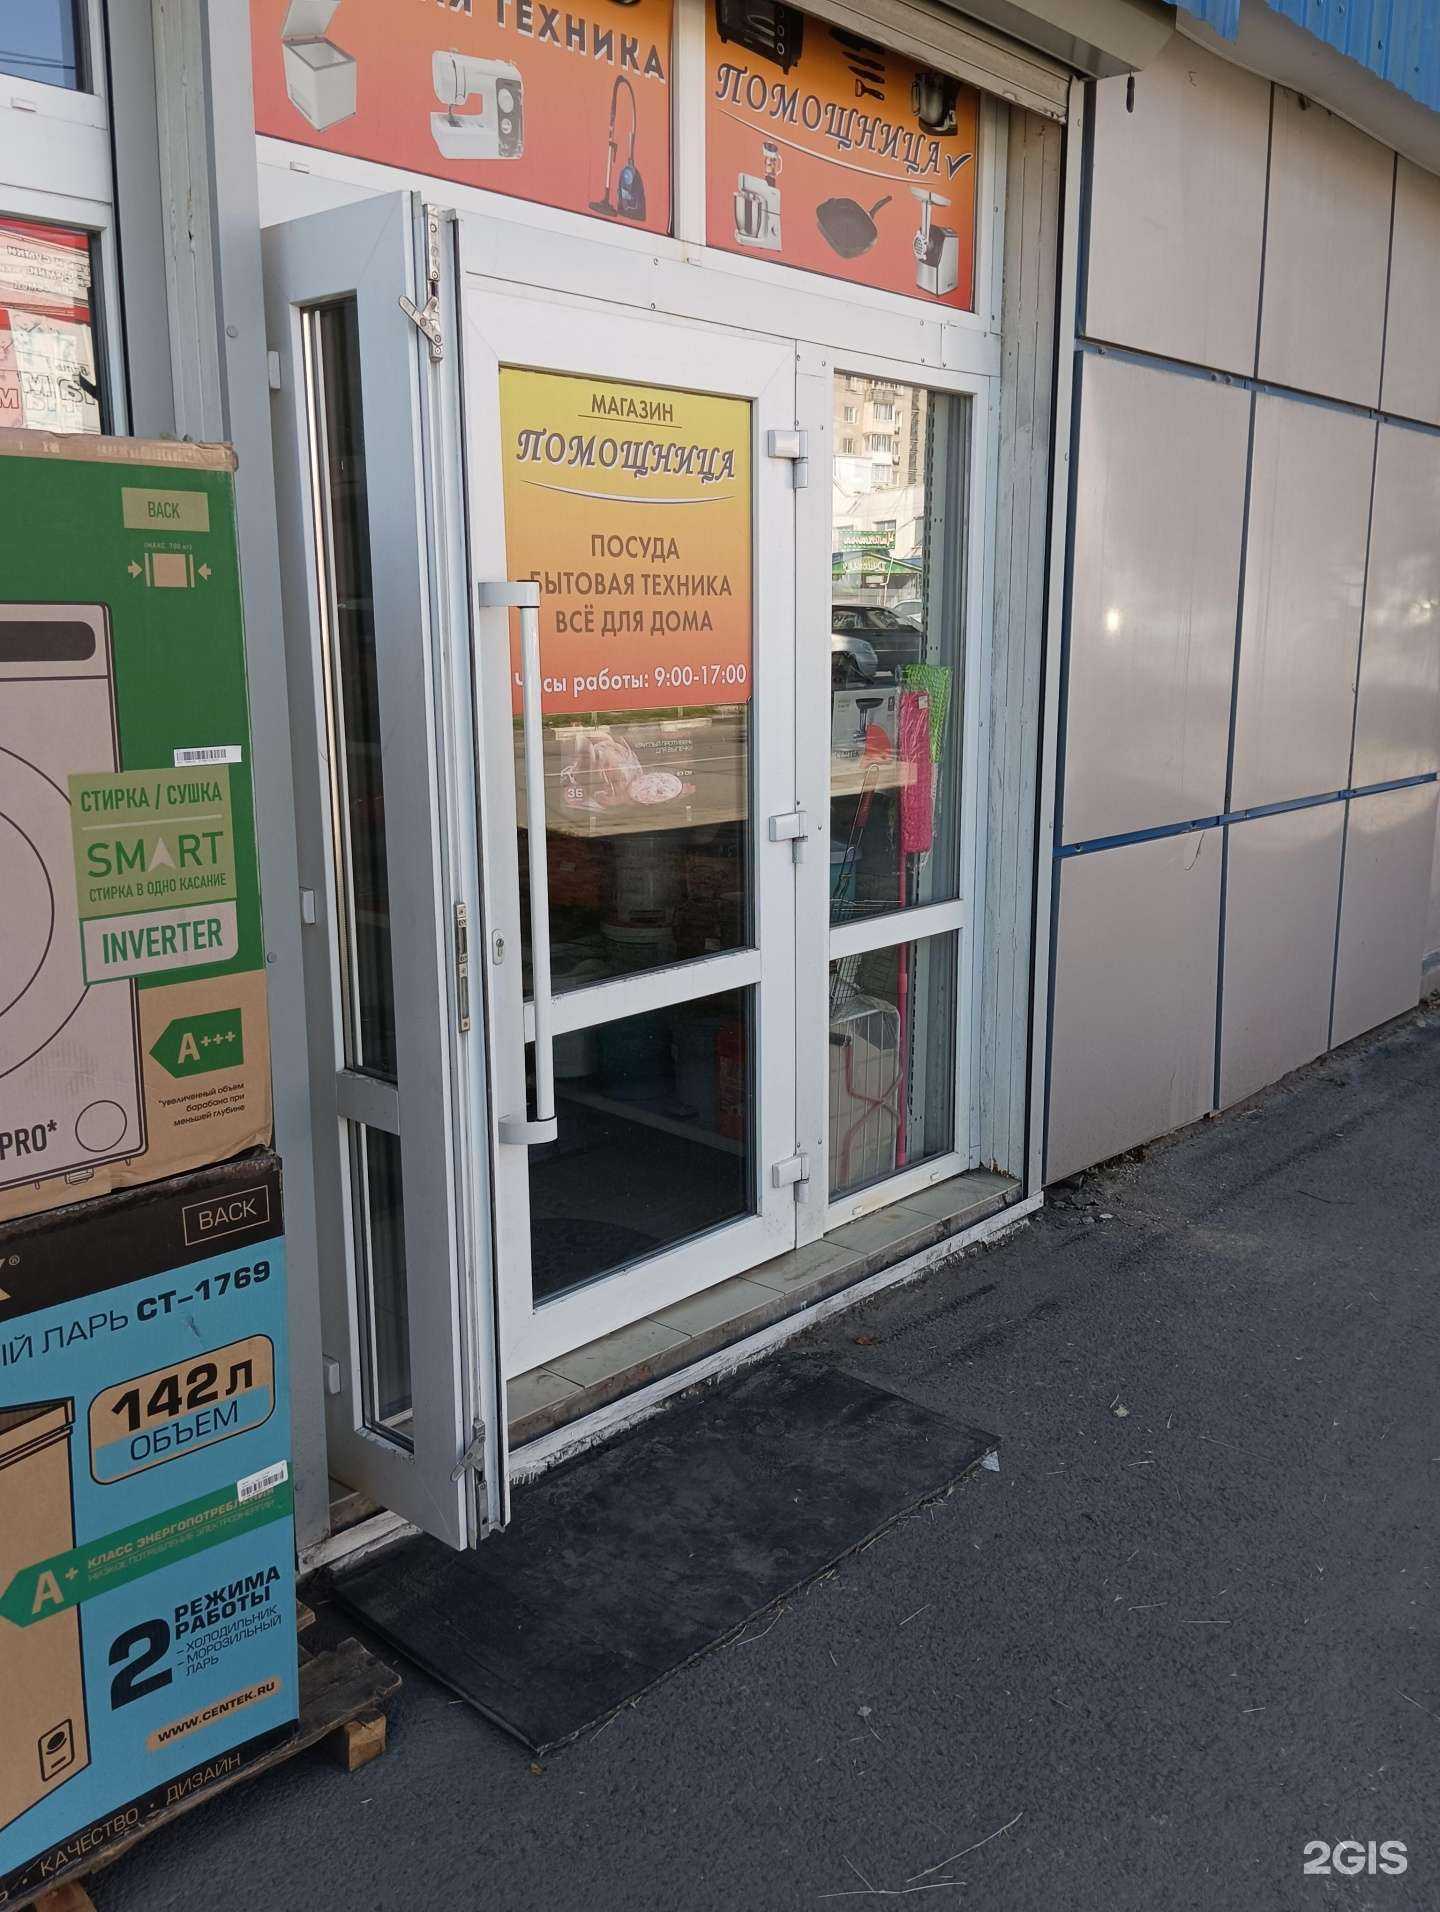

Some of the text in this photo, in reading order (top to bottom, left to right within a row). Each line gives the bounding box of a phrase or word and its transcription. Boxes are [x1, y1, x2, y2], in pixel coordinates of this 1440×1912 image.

[497, 0, 665, 83] ТЕХНИКА
[715, 62, 941, 175] ПОМОЩНИЦА
[591, 393, 673, 422] МАГАЗИН
[515, 427, 736, 483] ПОМОЩНИЦА
[147, 500, 181, 519] BACK
[591, 534, 680, 563] ПОСУДА
[641, 573, 732, 596] ТЕХНИКА
[555, 604, 713, 637] ВСЁ ДЛЯ ДОМА
[515, 664, 747, 697] сы работы: 9:00-17:00
[81, 786, 150, 812] СТИРКА
[166, 782, 223, 805] СУШКА
[87, 831, 224, 878] SMART
[89, 873, 227, 902] СТИРКА В ОДНО КАСАНИЕ
[102, 918, 223, 964] INVERTER
[174, 1104, 246, 1127] меньшей глубине
[186, 1093, 245, 1112] барабана при
[199, 1198, 257, 1231] BACK
[42, 1310, 129, 1354] ЛАРЬ
[130, 1400, 238, 1461] ОБЪЕМ
[88, 1543, 134, 1570] КЛАСС
[174, 1566, 281, 1623] РЕЖИМА
[175, 1586, 271, 1641] РАБОТЫ
[186, 1604, 279, 1652] ХОЛОДИЛЬНИК
[187, 1614, 283, 1665] МОРОЗИЛЬНЫЙ
[108, 1618, 173, 1712] 2
[186, 1656, 220, 1677] ЛАРЬ
[158, 1681, 276, 1743] WWW.CENTEK.RU
[40, 1752, 241, 1877] КАЧЕСТВО ДИЗАЙН
